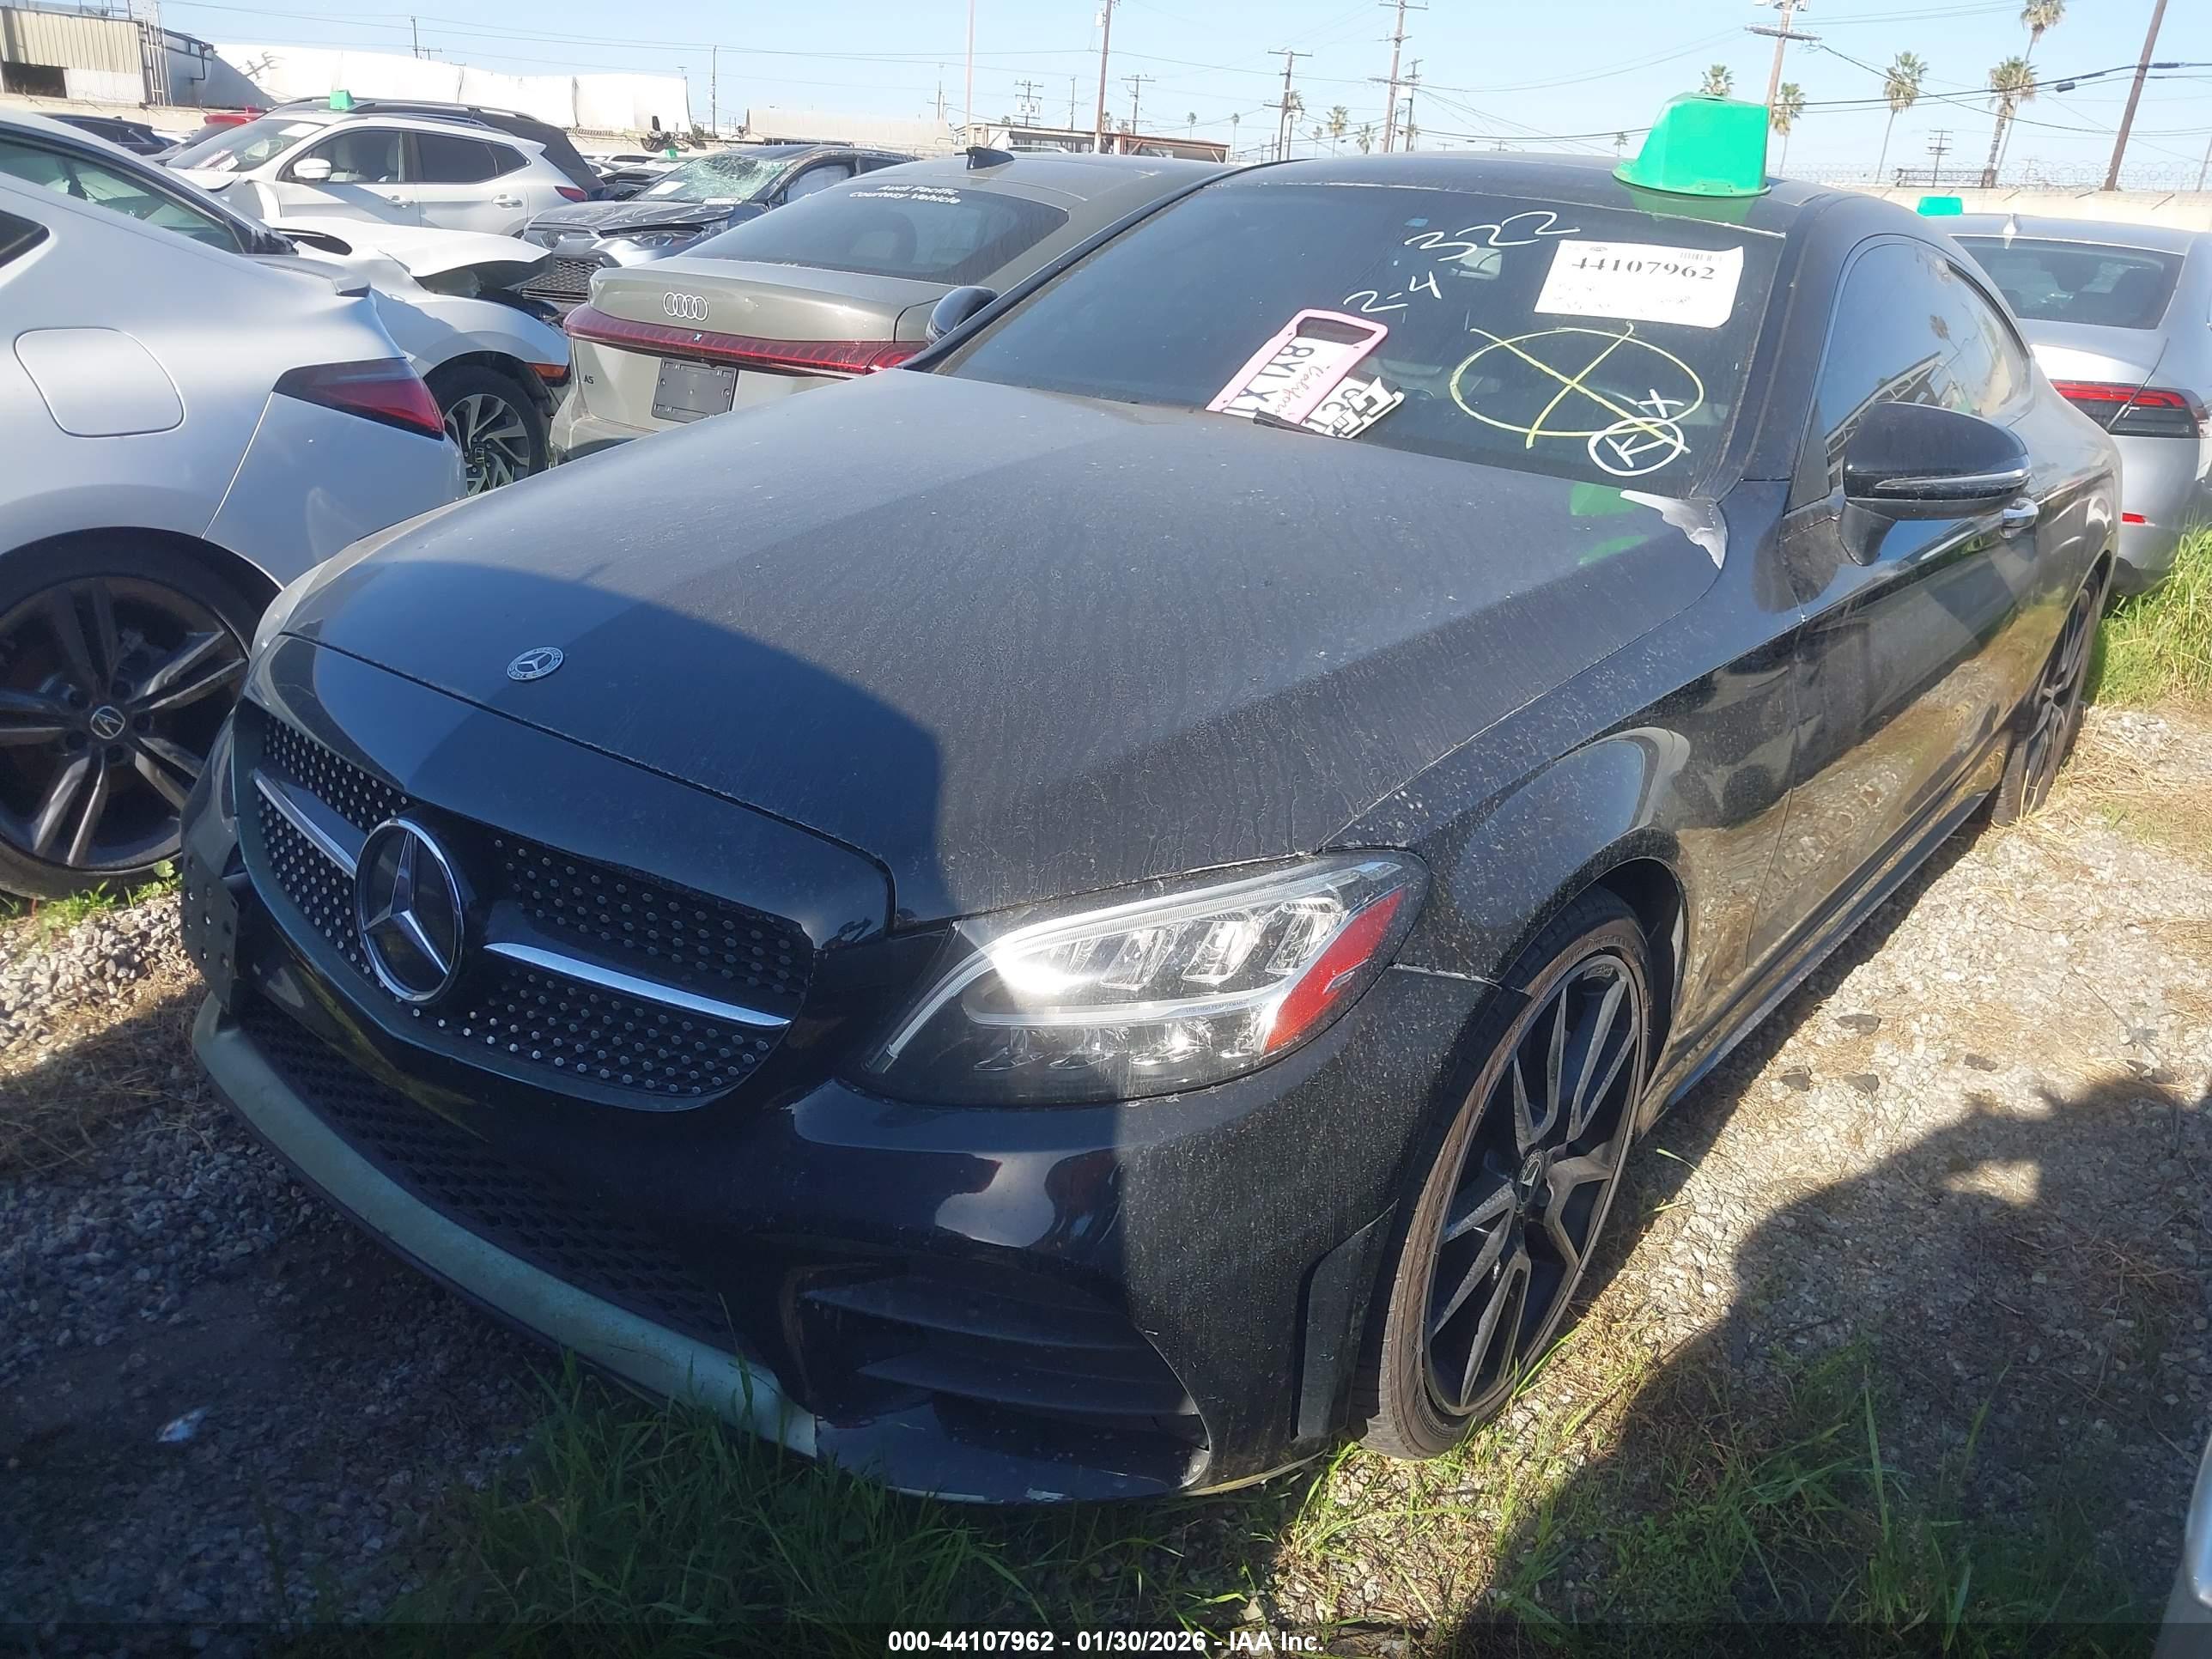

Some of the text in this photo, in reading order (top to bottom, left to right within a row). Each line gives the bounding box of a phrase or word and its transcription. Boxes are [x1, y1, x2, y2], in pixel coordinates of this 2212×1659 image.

[910, 185, 959, 196] Pacific
[910, 193, 962, 204] Vehicle
[1403, 210, 1581, 262] 322
[1571, 257, 1716, 280] 44107962
